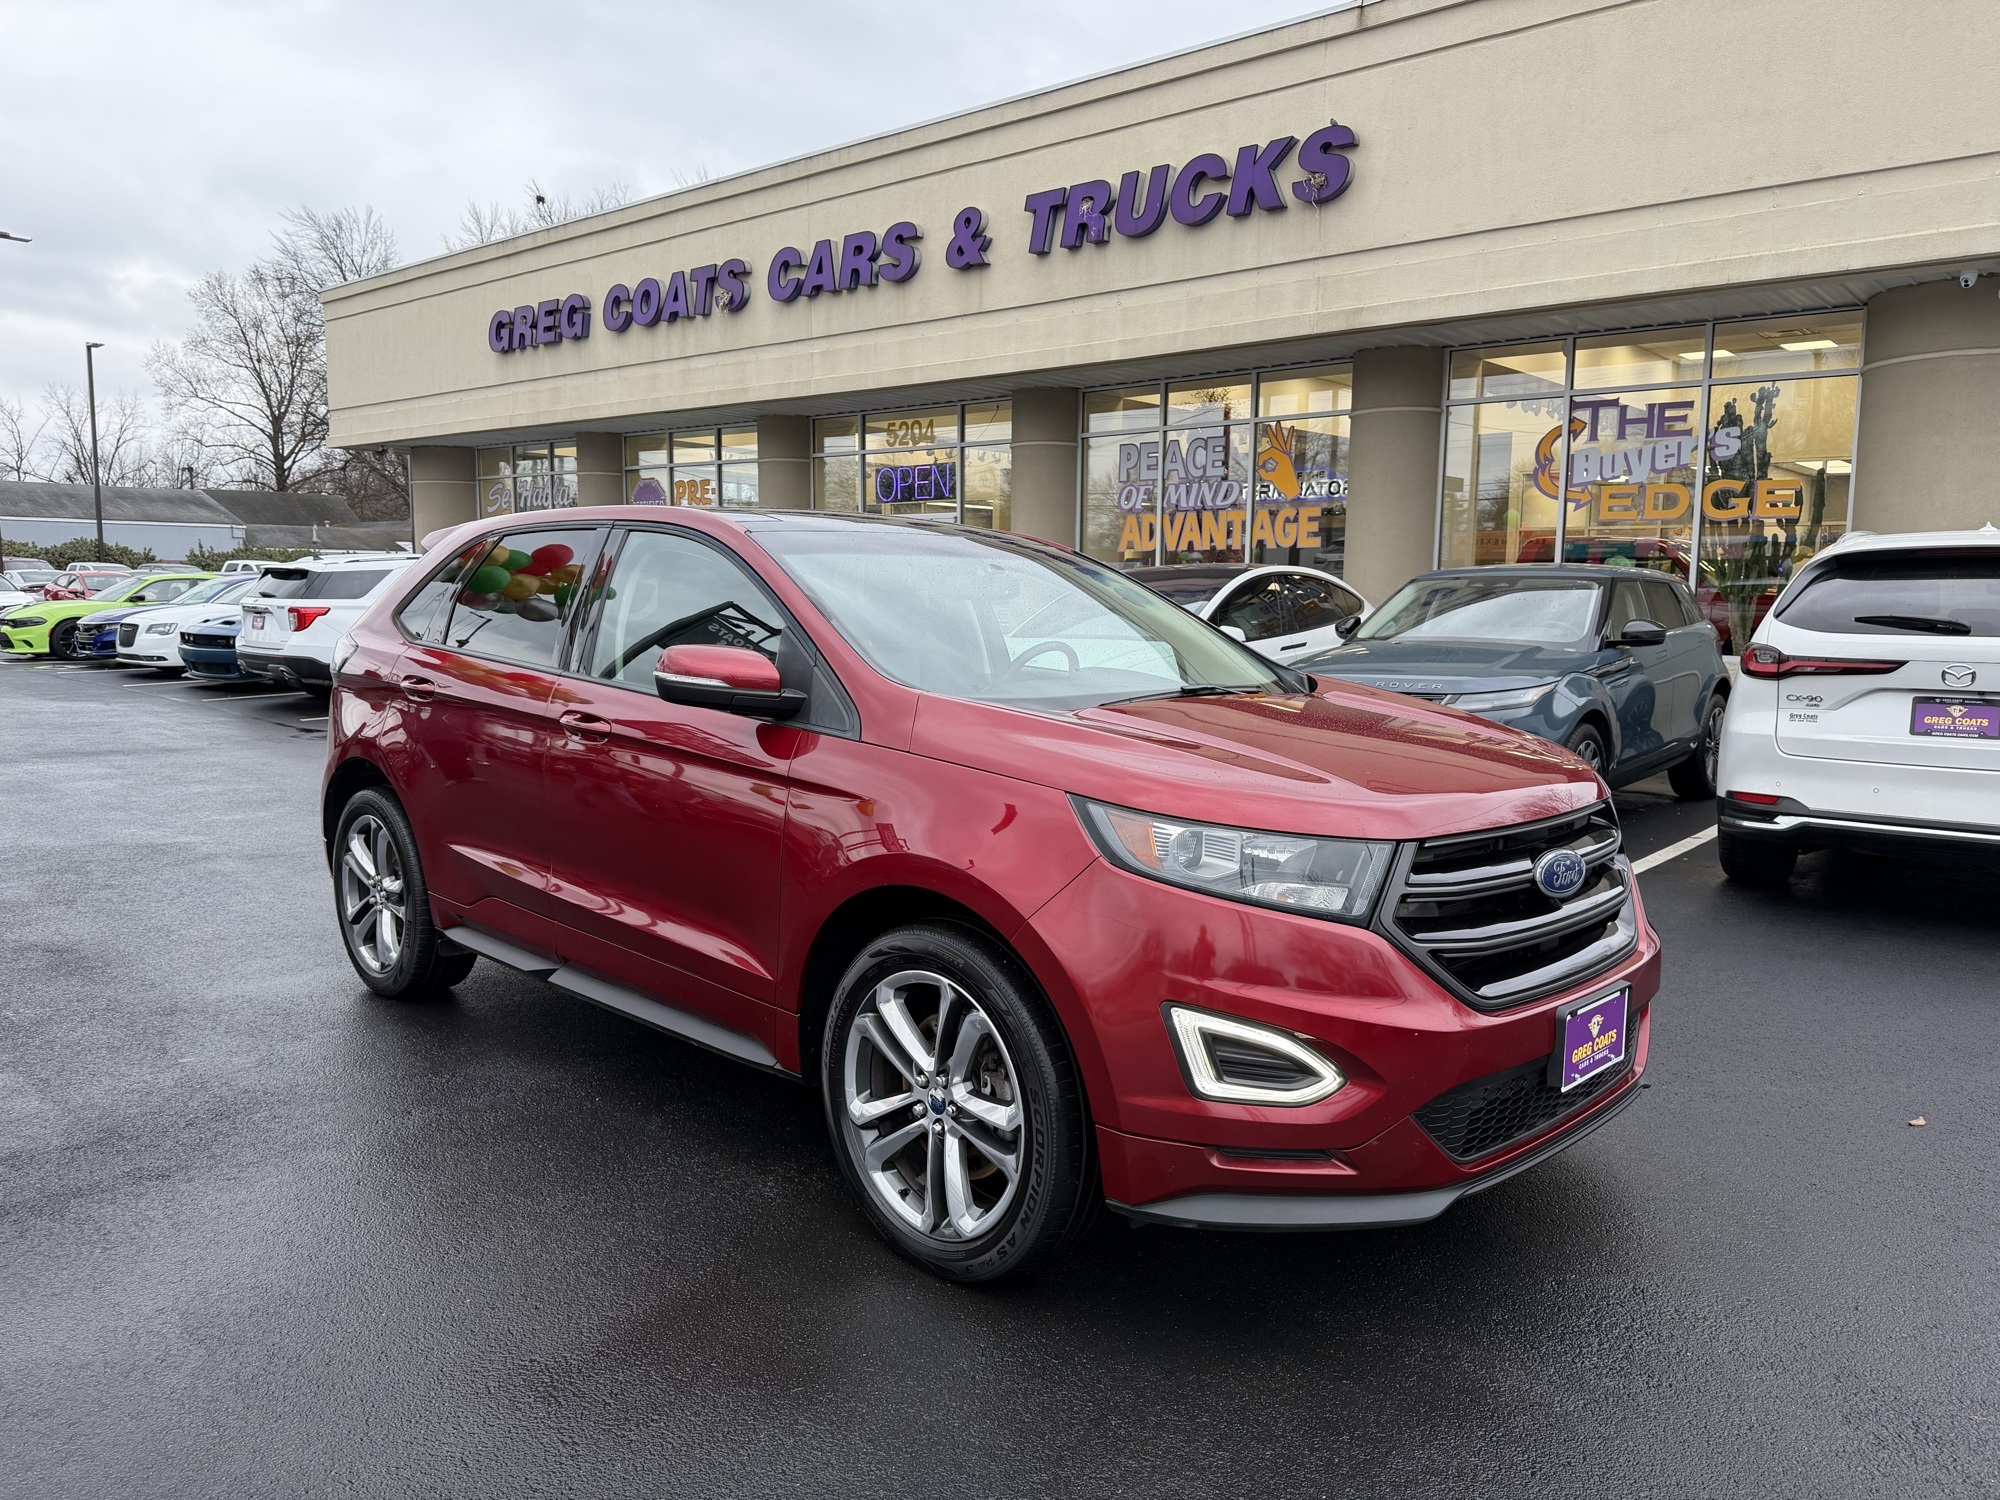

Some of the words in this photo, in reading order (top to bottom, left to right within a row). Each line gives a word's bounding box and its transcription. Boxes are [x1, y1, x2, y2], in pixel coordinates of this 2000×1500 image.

[488, 293, 591, 354] GREG
[602, 258, 752, 332] COATS
[768, 221, 924, 302] CARS
[945, 206, 993, 271] &
[1024, 124, 1360, 255] TRUCKS
[885, 419, 936, 447] 5204
[1571, 396, 1695, 443] THE
[1118, 435, 1226, 483] PEACE
[1570, 426, 1742, 488] Buyer's
[487, 482, 511, 513] Se
[518, 475, 570, 508] Habla
[876, 464, 950, 502] OPEN
[1118, 485, 1155, 512] OF
[1162, 479, 1242, 511] MIND
[1597, 478, 1804, 521] EDGE
[1118, 507, 1322, 552] ADVANTAGE
[1375, 681, 1443, 690] ROVER
[1786, 694, 1823, 703] CX-90
[1924, 716, 1953, 725] GREG
[1955, 718, 1989, 726] COATS
[1553, 860, 1581, 888] Ford
[1572, 1041, 1593, 1064] GREG
[1594, 1029, 1617, 1051] COATS
[1019, 1087, 1046, 1232] SCORPION
[997, 1231, 1017, 1261] AS
[965, 1264, 974, 1274] 3
